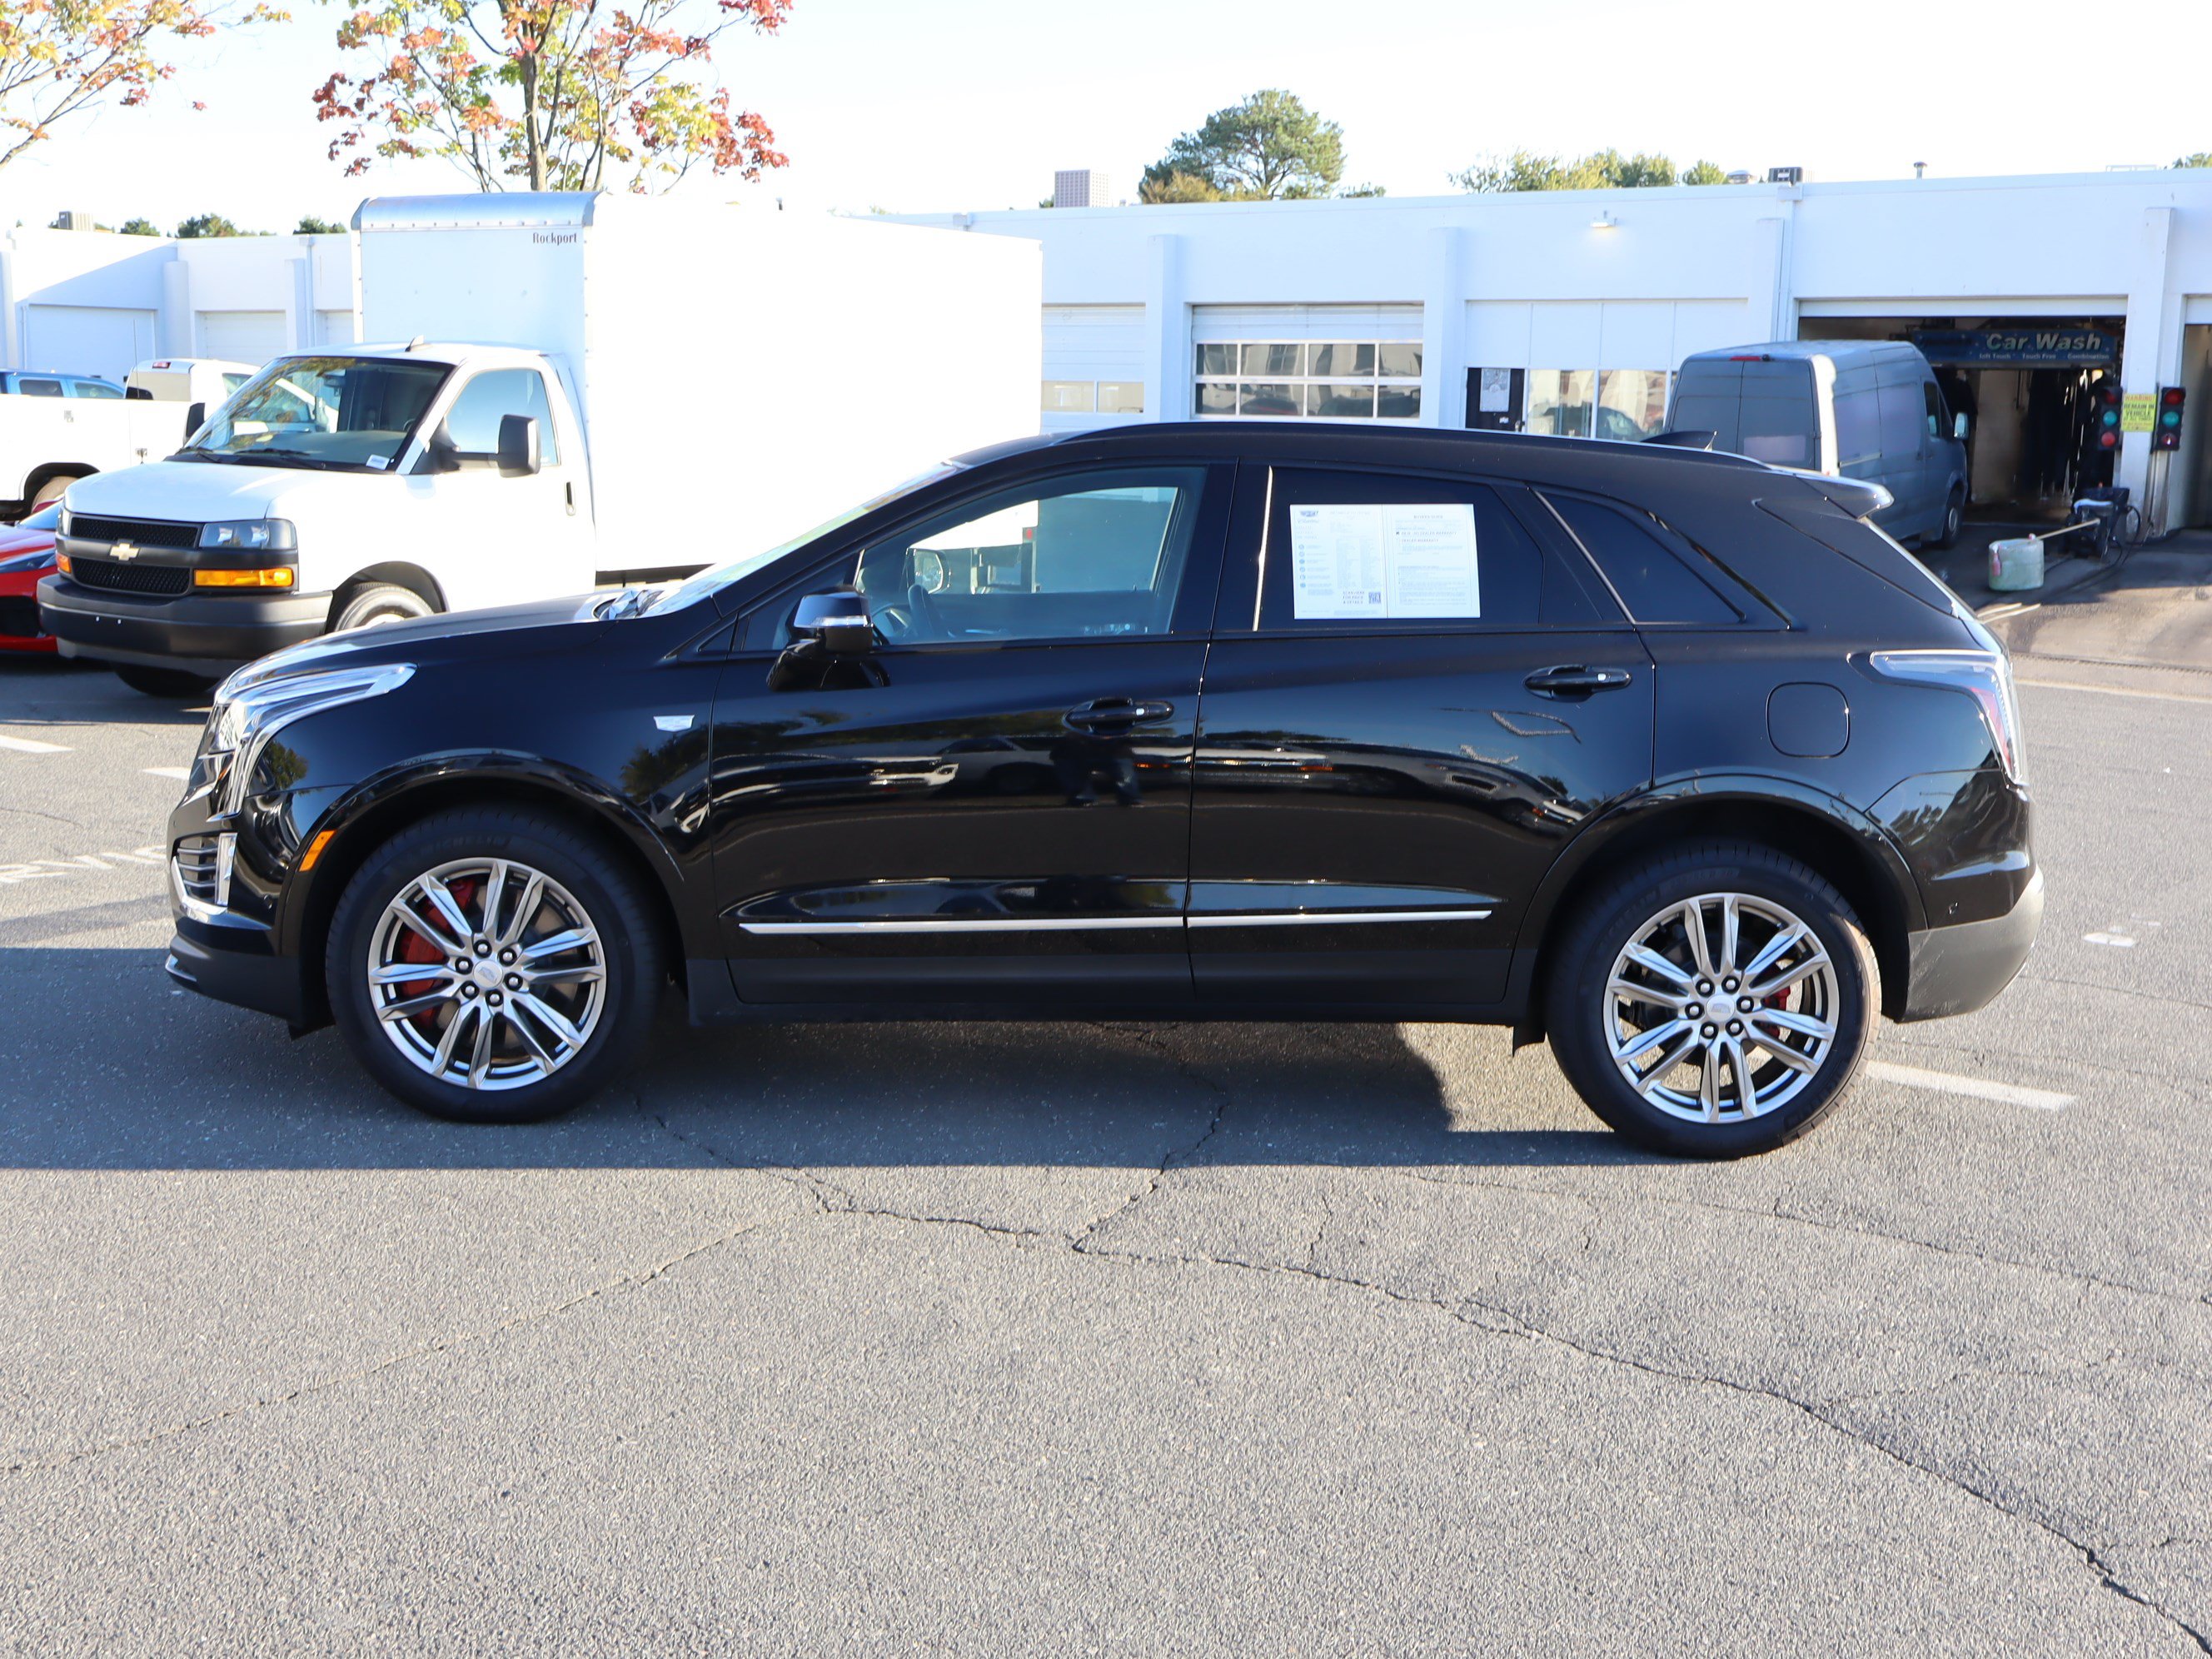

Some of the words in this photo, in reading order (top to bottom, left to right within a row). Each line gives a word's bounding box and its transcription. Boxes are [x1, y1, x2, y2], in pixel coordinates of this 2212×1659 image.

[533, 232, 577, 246] Rockport
[1986, 333, 2029, 350] Car
[2036, 333, 2101, 350] Wash
[419, 835, 507, 856] MICHELIN
